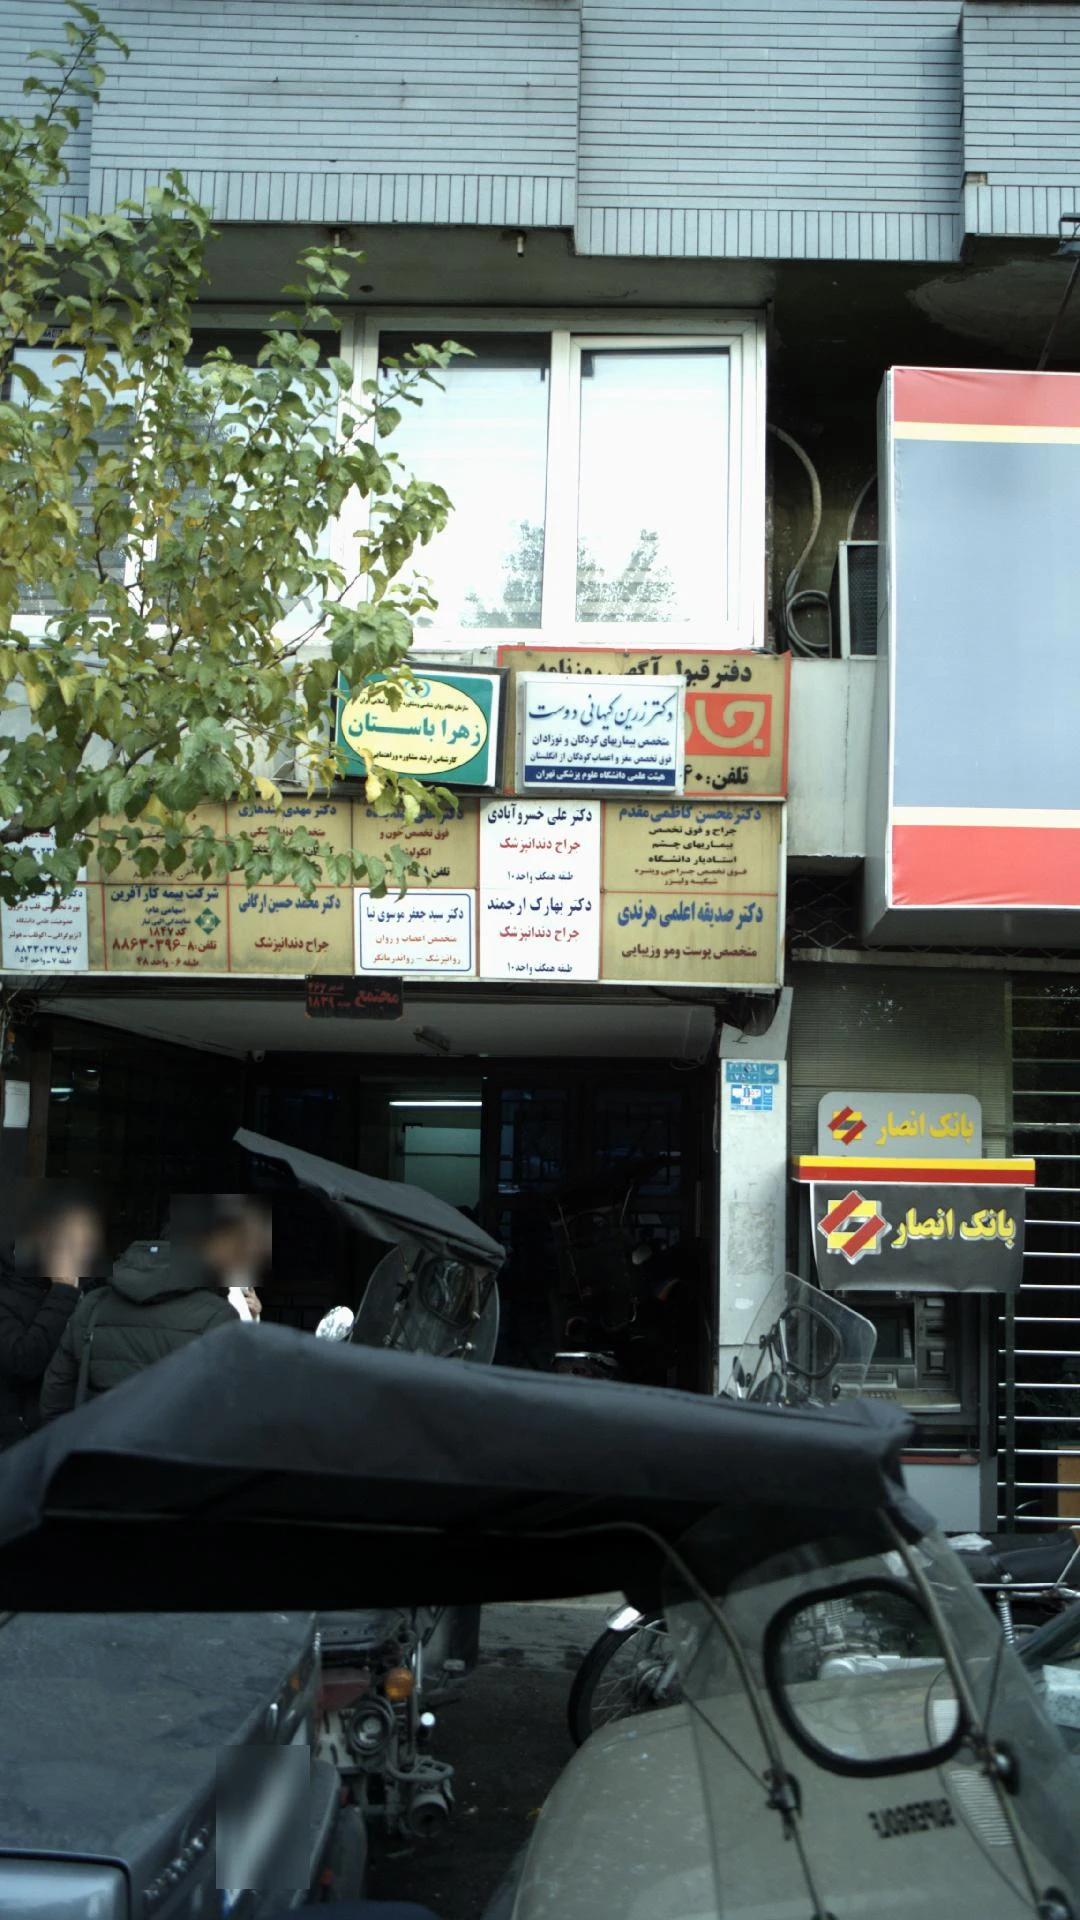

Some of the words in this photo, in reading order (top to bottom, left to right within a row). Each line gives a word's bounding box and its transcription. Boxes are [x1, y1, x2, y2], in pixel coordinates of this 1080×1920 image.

[711, 661, 752, 688] دفتر
[529, 705, 577, 719] دوست
[580, 694, 622, 730] کیهانی
[615, 701, 647, 730] زرین
[643, 692, 678, 727] دکتر
[348, 712, 435, 742] باستان
[441, 718, 481, 746] زهرا
[532, 733, 562, 746] نوزادان
[565, 738, 568, 746] و
[571, 734, 599, 747] کودکان
[637, 737, 670, 748] متخصص
[559, 753, 565, 763] از
[567, 753, 591, 763] کودکان
[592, 753, 614, 762] اعصاب
[622, 755, 632, 764] مغز
[634, 755, 657, 764] تخصص
[659, 756, 671, 765] فوق
[536, 769, 555, 780] تهران
[556, 770, 581, 781] پزشکی
[581, 771, 599, 781] علوم
[600, 771, 626, 779] دانشگاه
[627, 772, 646, 782] علمی
[238, 805, 277, 817] ندهاری
[283, 806, 311, 817] مهدی
[315, 804, 336, 818] دکتر
[547, 807, 567, 826] علی
[570, 809, 592, 826] دکتر
[619, 806, 649, 821] مقدم
[651, 805, 693, 822] کاظمی
[695, 808, 732, 823] محسن
[734, 807, 761, 824] دکتر
[386, 829, 402, 839] خون
[405, 829, 433, 839] تخصص
[434, 830, 449, 840] فوق
[684, 828, 703, 836] فوق
[712, 827, 737, 836] جراح
[500, 837, 552, 853] دندانپزشک
[555, 839, 580, 854] جراح
[652, 840, 680, 849] چشم
[649, 855, 691, 863] دانشگاه
[694, 856, 737, 865] استادیار
[431, 866, 450, 878] تلفن
[535, 871, 555, 881] همکف
[558, 871, 573, 880] طبقه
[163, 889, 183, 900] بیمه
[186, 887, 218, 902] شرکت
[268, 899, 293, 913] حسین
[295, 899, 319, 909] محمد
[321, 894, 341, 914] دکتر
[487, 897, 526, 915] ارجمند
[568, 897, 592, 916] دکتر
[367, 906, 376, 922] نیا
[377, 910, 405, 923] موسوی
[407, 907, 426, 923] جعفر
[428, 910, 443, 922] سید
[446, 907, 464, 923] دکتر
[617, 899, 657, 927] هرندی
[659, 900, 695, 927] اعلمی
[697, 902, 734, 927] صدیقه
[736, 902, 764, 930] دکتر
[175, 927, 186, 936] کد
[499, 926, 551, 942] دندانپزشک
[554, 928, 579, 942] جراح
[255, 937, 303, 952] دندانپزشک
[306, 938, 329, 952] جراح
[376, 935, 393, 944] روان
[683, 946, 712, 960] پوست
[713, 945, 757, 959] متخصص
[534, 962, 555, 972] همکف
[557, 963, 573, 973] طبقه
[875, 1110, 926, 1145] انصار
[929, 1112, 975, 1142] بانک
[891, 1207, 955, 1249] انصار
[959, 1208, 1017, 1249] بانک
